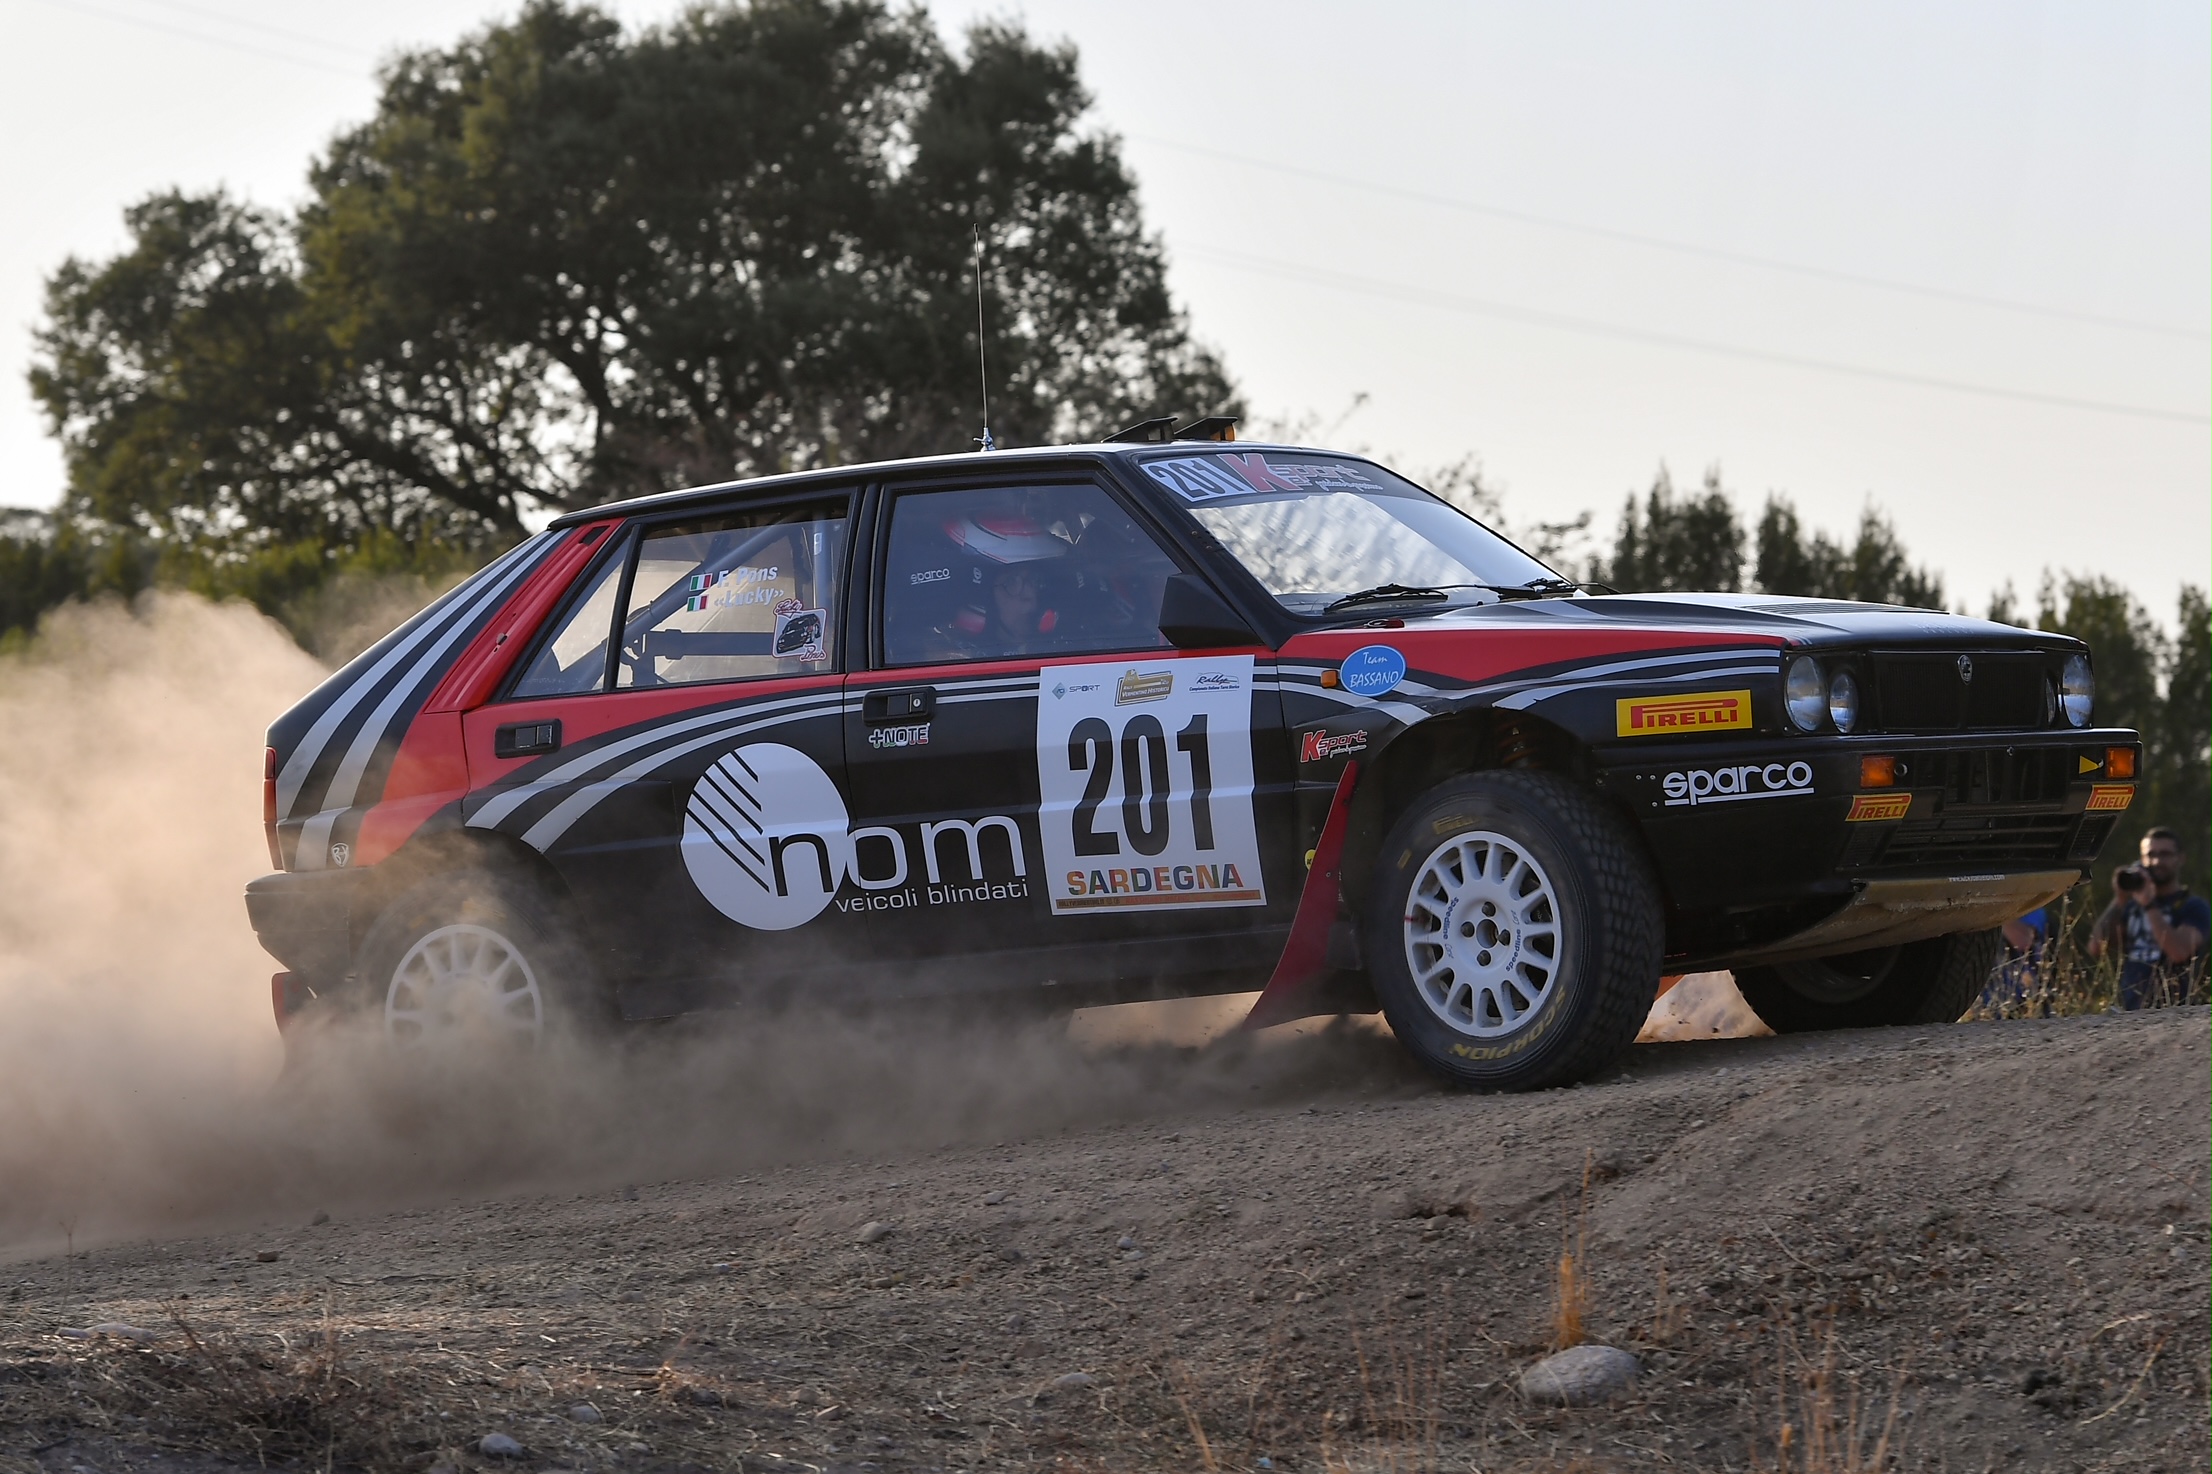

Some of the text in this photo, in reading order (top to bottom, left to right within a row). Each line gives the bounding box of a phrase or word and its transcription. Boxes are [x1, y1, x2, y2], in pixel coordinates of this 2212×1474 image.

[1147, 459, 1245, 499] 201
[736, 565, 778, 586] Pons
[911, 568, 950, 585] sparco
[1363, 651, 1388, 664] Team
[1069, 684, 1101, 693] SPORT
[1350, 671, 1399, 688] BASSANO
[1630, 698, 1739, 729] PIRELLI
[1067, 713, 1215, 857] 201
[1662, 761, 1815, 806] sparco
[2087, 786, 2134, 809] PIRELLI
[1849, 795, 1911, 819] PIRELLI
[768, 815, 1027, 897] nom
[1066, 863, 1244, 896] SARDEGNA
[835, 879, 1030, 914] veicoli blindati
[1443, 896, 1460, 940] speedline
[1505, 928, 1522, 972] speedline
